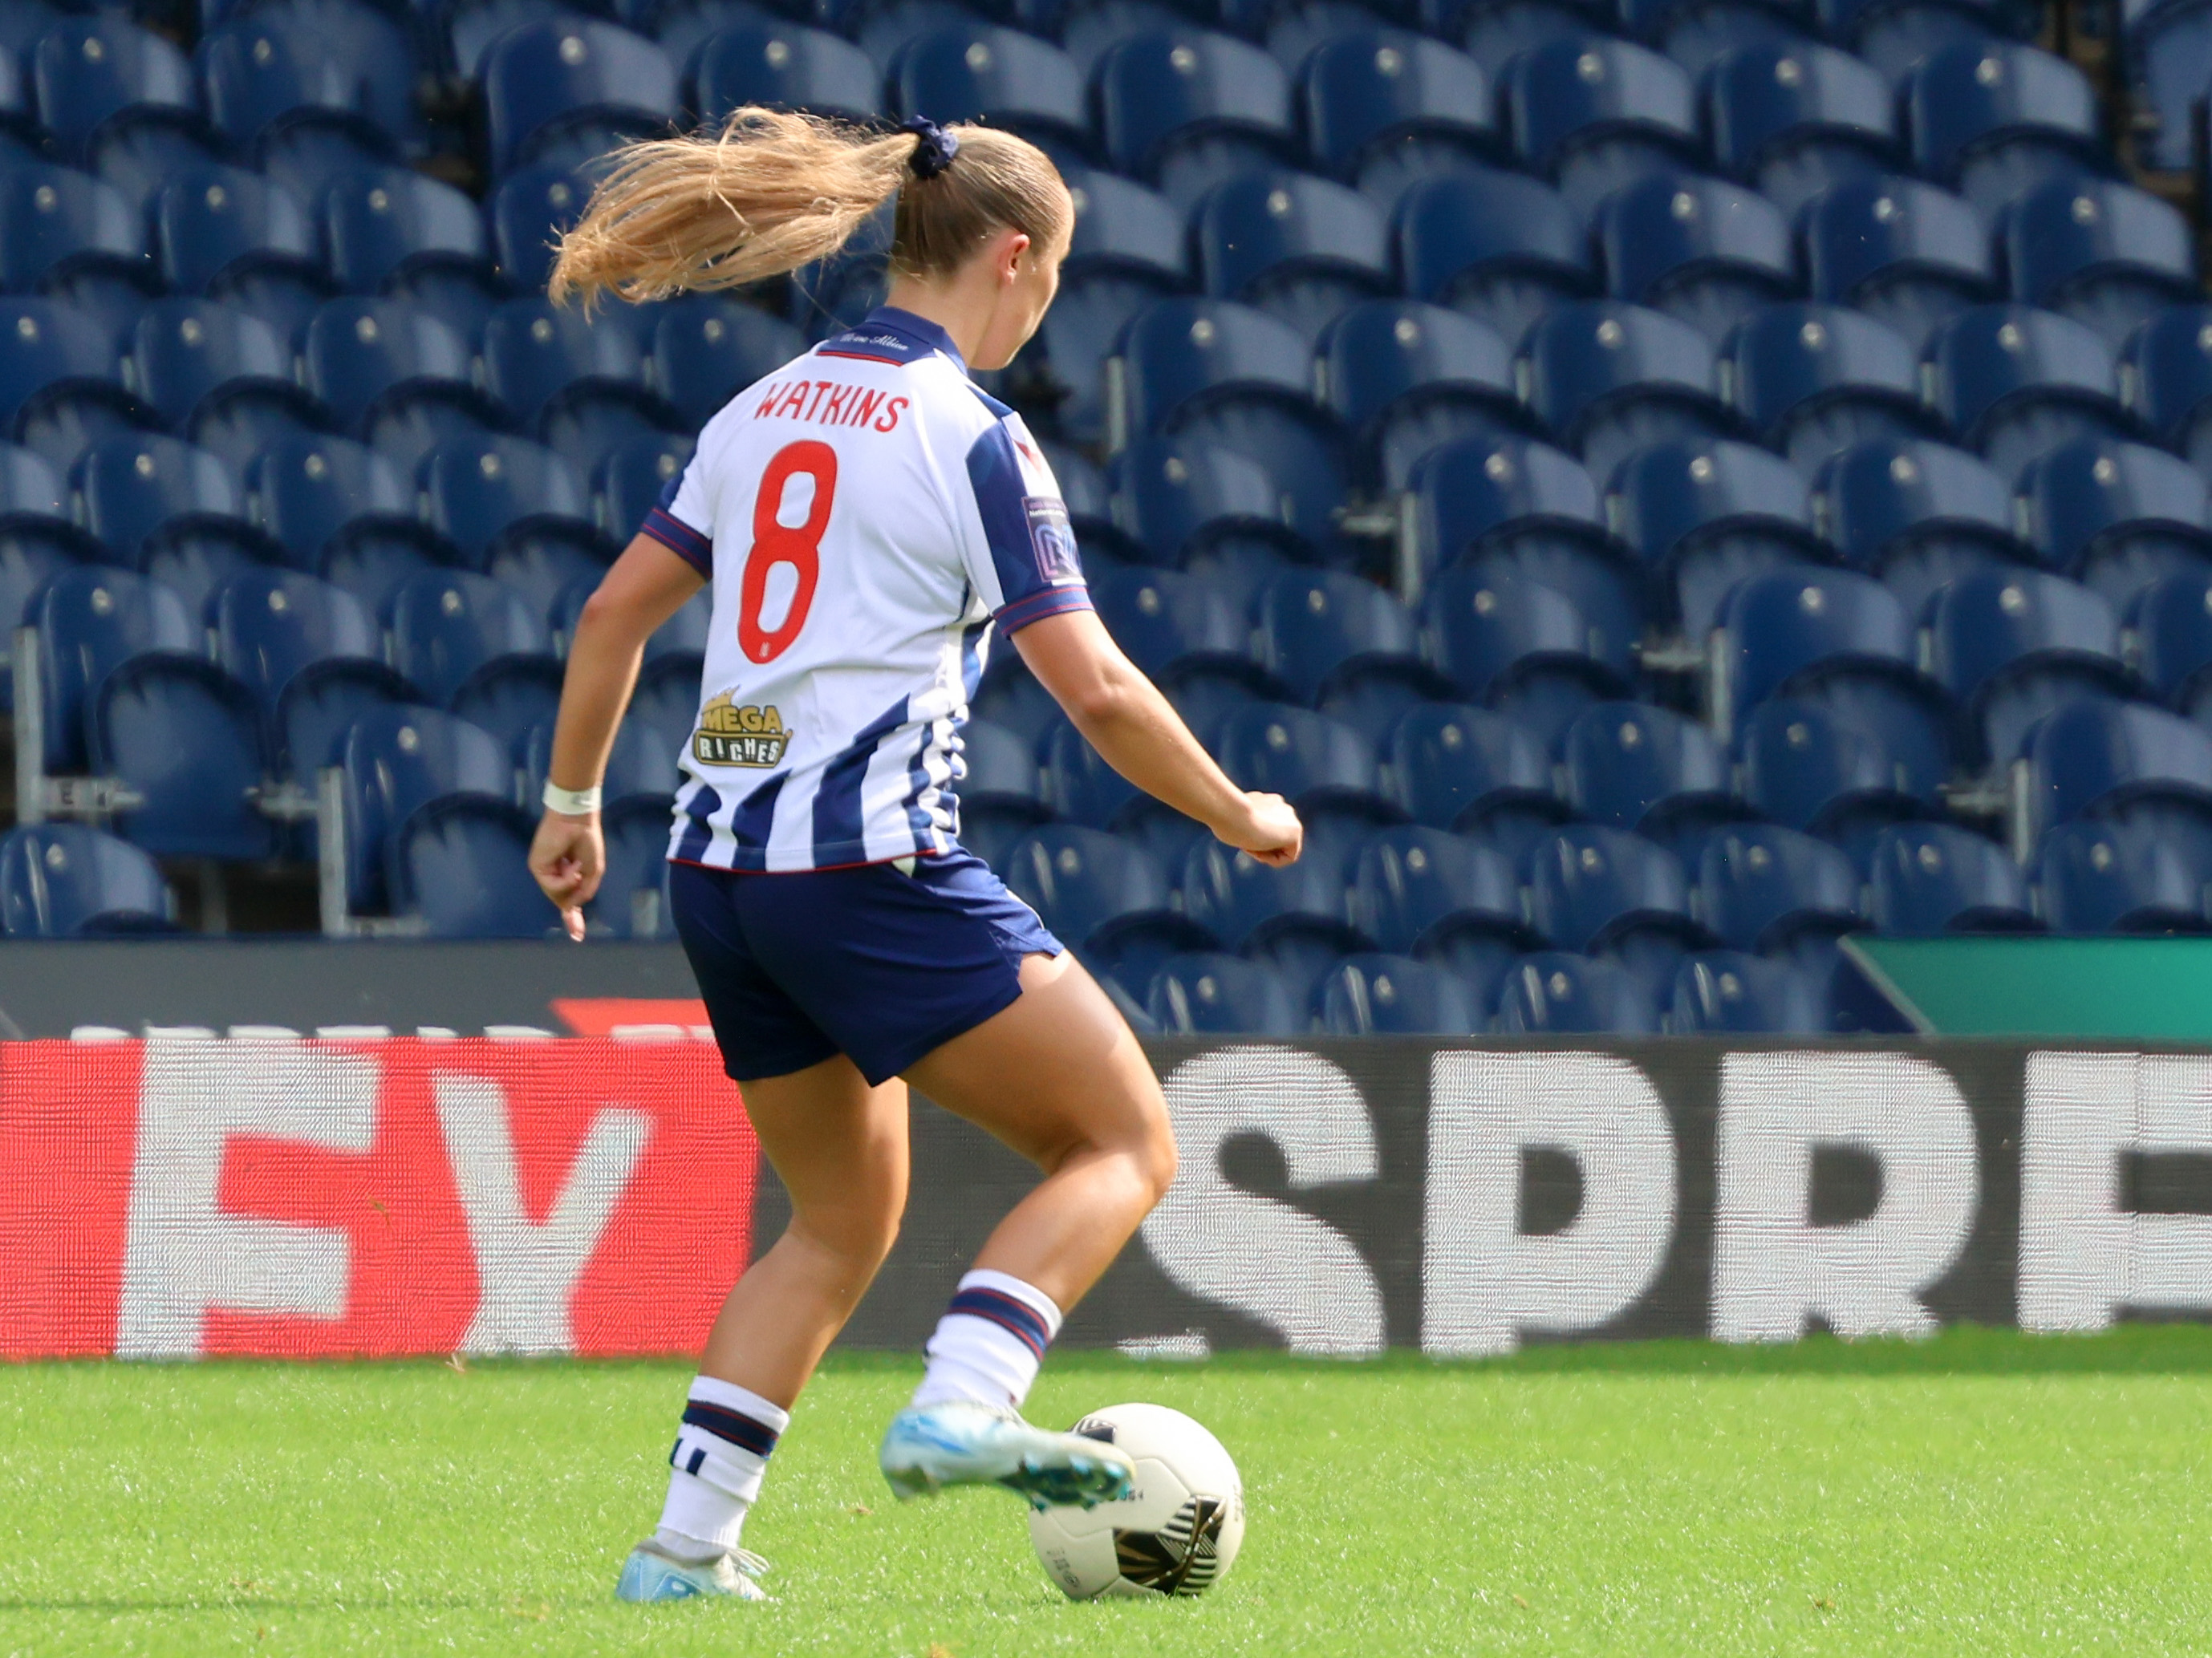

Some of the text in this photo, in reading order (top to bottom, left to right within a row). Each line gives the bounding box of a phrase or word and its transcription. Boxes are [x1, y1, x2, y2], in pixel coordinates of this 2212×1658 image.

[754, 380, 909, 432] WATKINS
[737, 439, 838, 664] 8
[700, 705, 782, 734] MEGA
[699, 737, 780, 763] RICHES
